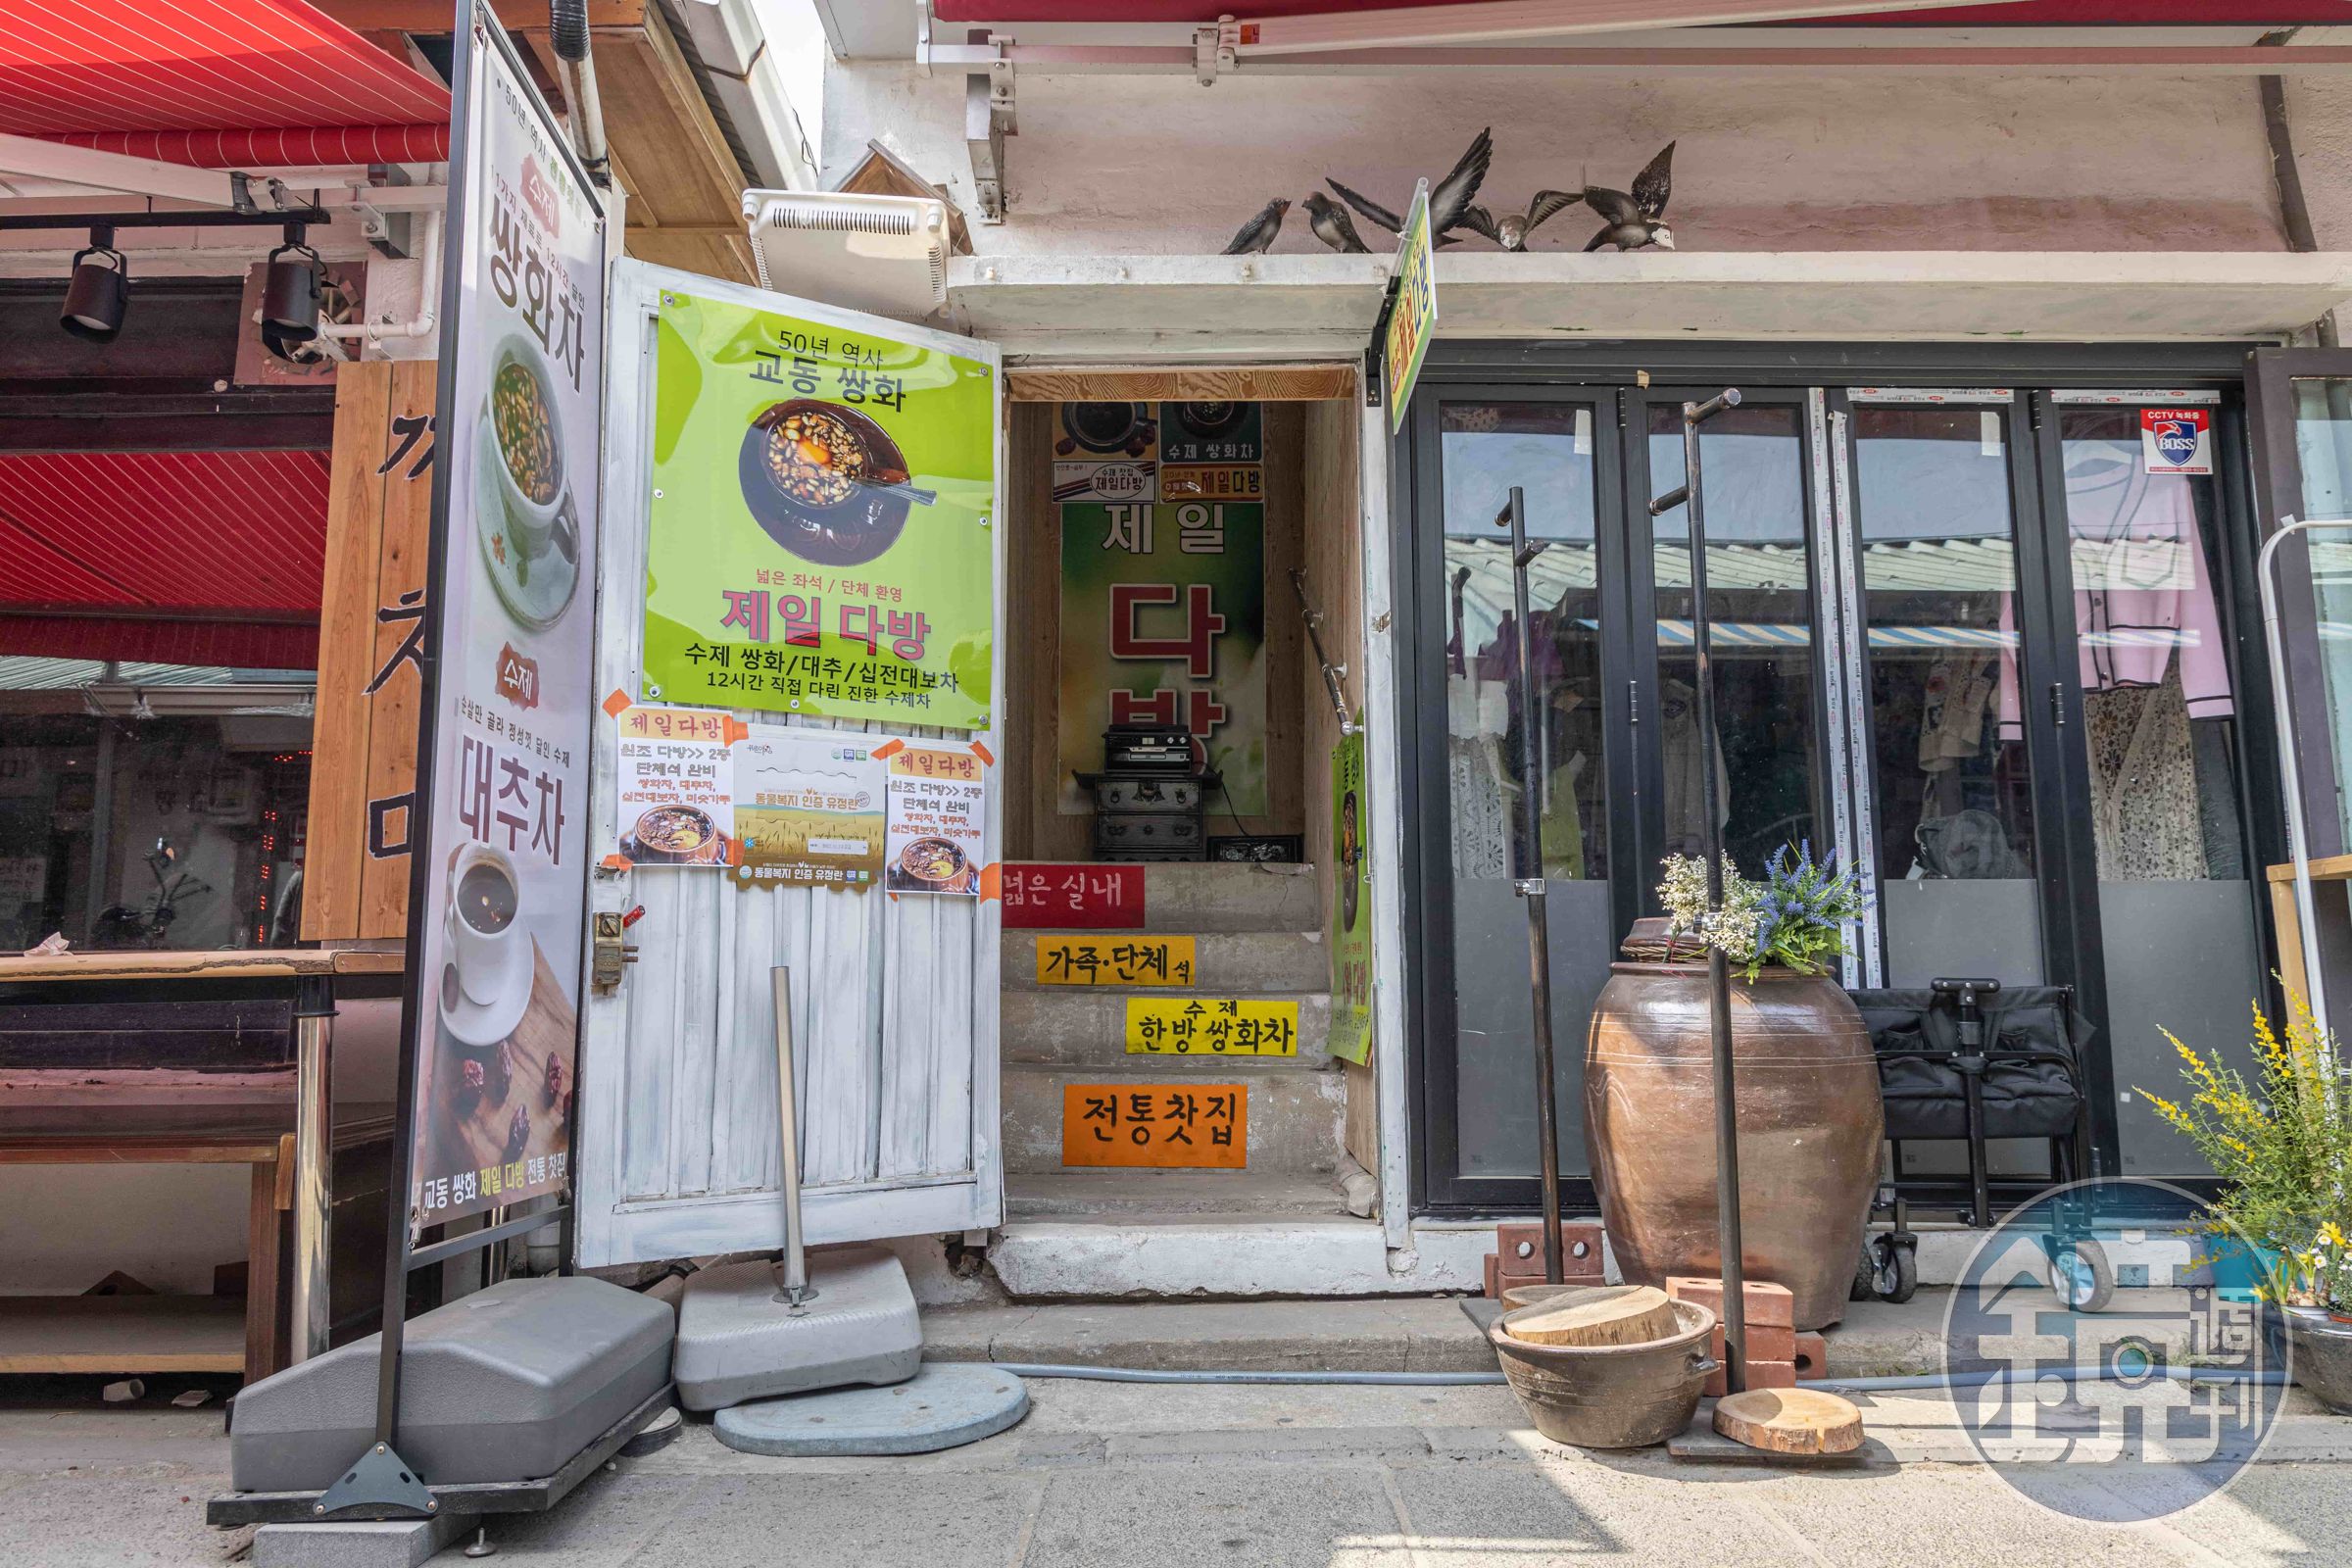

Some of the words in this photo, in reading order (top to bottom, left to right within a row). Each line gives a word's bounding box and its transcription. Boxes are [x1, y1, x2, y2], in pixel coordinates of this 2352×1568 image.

[528, 174, 555, 228] 수제
[489, 193, 585, 393] 쌍화차
[778, 329, 830, 361] 50년
[841, 341, 884, 372] 역사
[749, 349, 822, 395] 교동
[836, 366, 907, 413] 쌍화
[2147, 411, 2175, 420] CCTV
[1167, 444, 1199, 460] 수제
[1205, 443, 1255, 461] 쌍화차
[2159, 437, 2195, 451] BOSS
[1094, 476, 1145, 491] 제일다방
[1200, 469, 1261, 494] 제일다방
[1102, 503, 1225, 555] 제일
[755, 567, 787, 587] 넓은
[791, 572, 823, 592] 좌석
[840, 579, 870, 599] 단체
[874, 583, 904, 603] 환영
[719, 589, 821, 649] 제일
[839, 604, 932, 662] 다방
[684, 642, 731, 669] 수제
[504, 658, 533, 701] 수제
[707, 672, 765, 692] 12시간
[770, 676, 803, 698] 직접
[808, 680, 841, 701] 다린
[847, 685, 879, 705] 진한
[884, 689, 932, 710] 수제차
[487, 710, 504, 736] 골라
[554, 747, 570, 769] 수제
[629, 712, 723, 740] 제일다방
[636, 761, 681, 777] 단체석
[687, 763, 716, 778] 완비
[898, 752, 976, 779] 제일다방
[459, 734, 565, 866] 대추차
[755, 792, 799, 808] 동물복지
[802, 795, 824, 808] 인증
[903, 797, 941, 812] 단체석
[945, 800, 970, 814] 완비
[794, 868, 813, 880] 인증
[814, 869, 844, 881] 유정란
[1003, 870, 1052, 906] 넓은
[1060, 872, 1123, 910] 실내
[1183, 1000, 1238, 1020] 수제
[1138, 1015, 1197, 1054] 한방
[1204, 1017, 1295, 1054] 쌍화차
[424, 1177, 449, 1210] 교동
[452, 1170, 477, 1205] 쌍화
[479, 1164, 502, 1197] 제일
[505, 1160, 525, 1191] 다방
[527, 1156, 546, 1185] 전통
